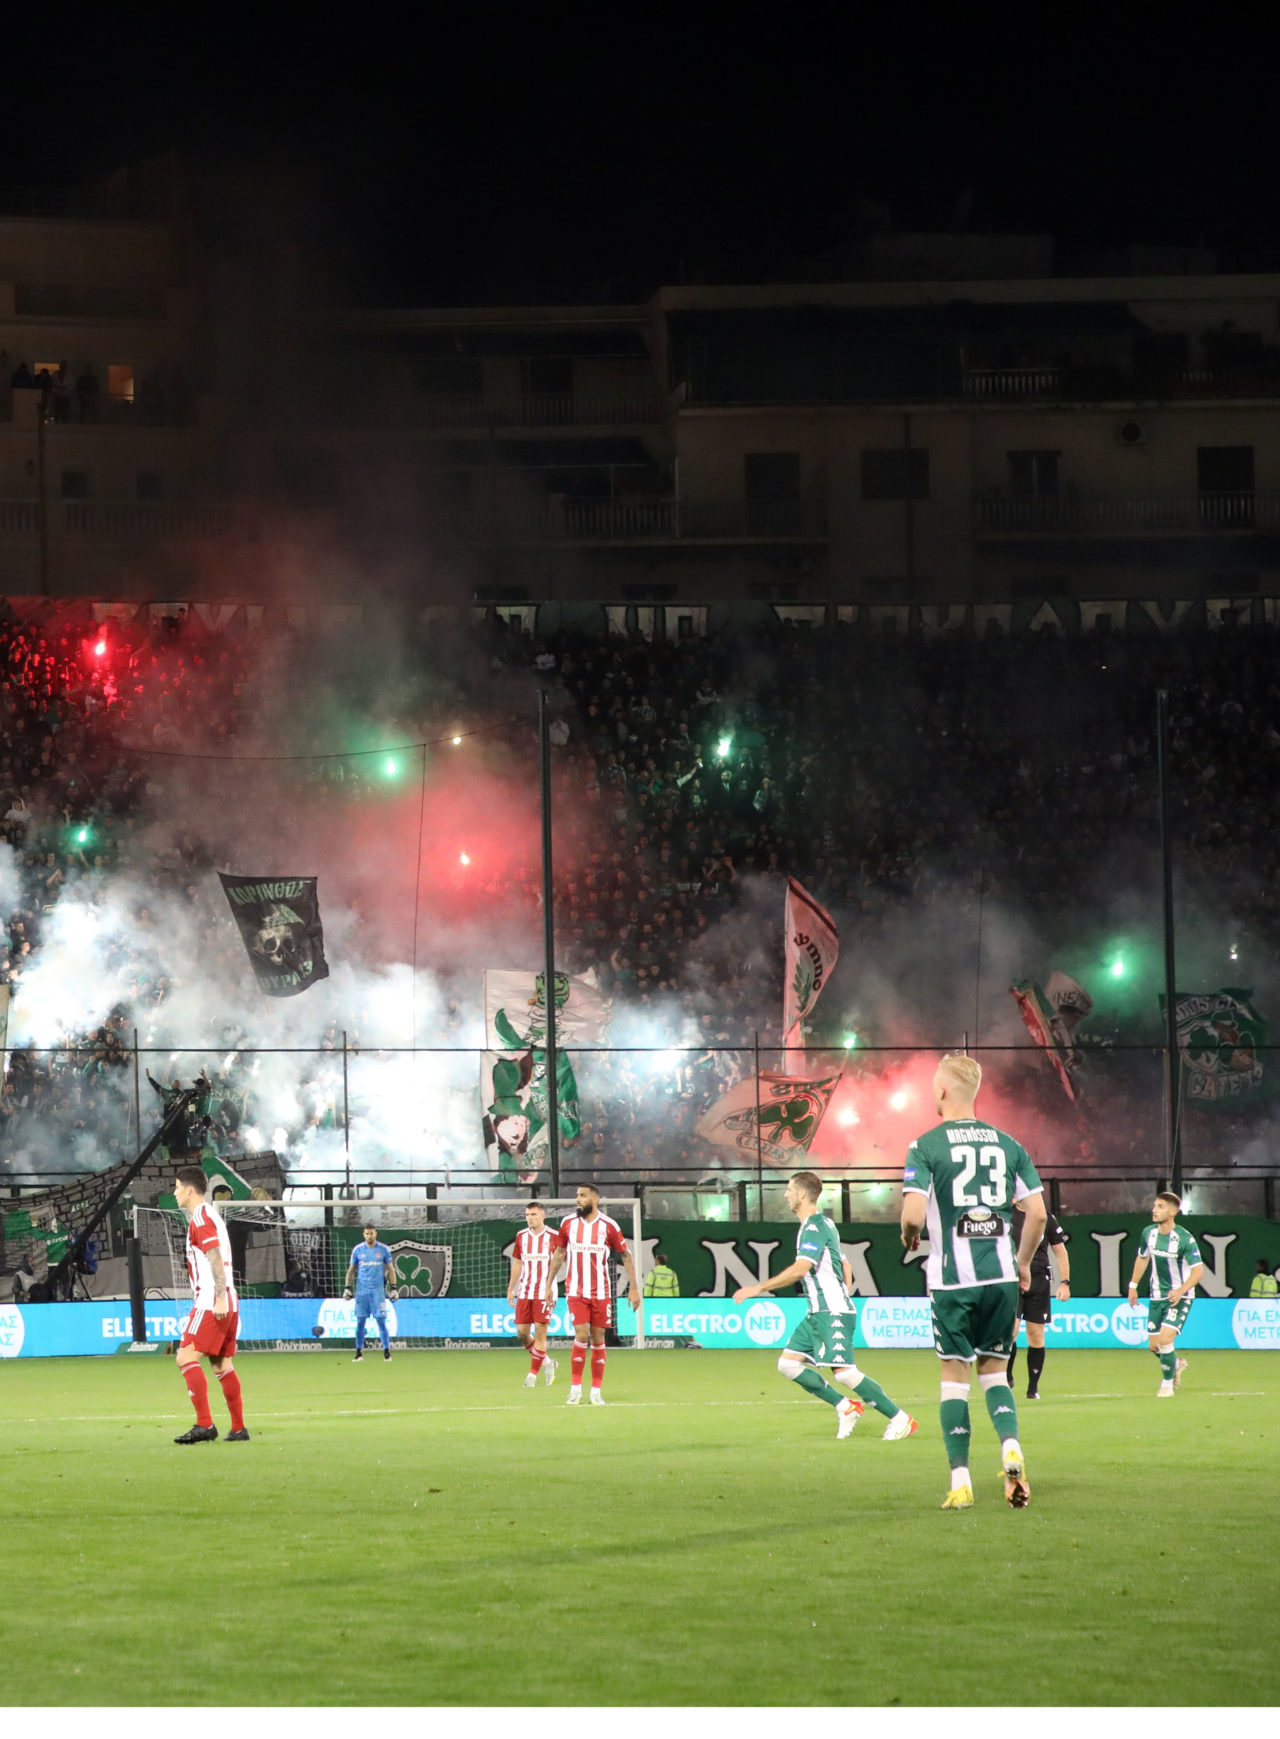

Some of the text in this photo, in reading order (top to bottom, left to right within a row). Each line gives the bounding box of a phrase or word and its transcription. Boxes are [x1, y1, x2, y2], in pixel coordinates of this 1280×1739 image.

[950, 1145, 1007, 1207] 23
[963, 1220, 997, 1235] Fuego
[867, 1308, 888, 1321] ΓΙΑ
[1238, 1309, 1261, 1322] ΓΙΑ
[650, 1313, 781, 1333] ELECTRO NET
[1117, 1316, 1149, 1331] NET
[872, 1324, 930, 1338] ΜΕΤΡΑΣ
